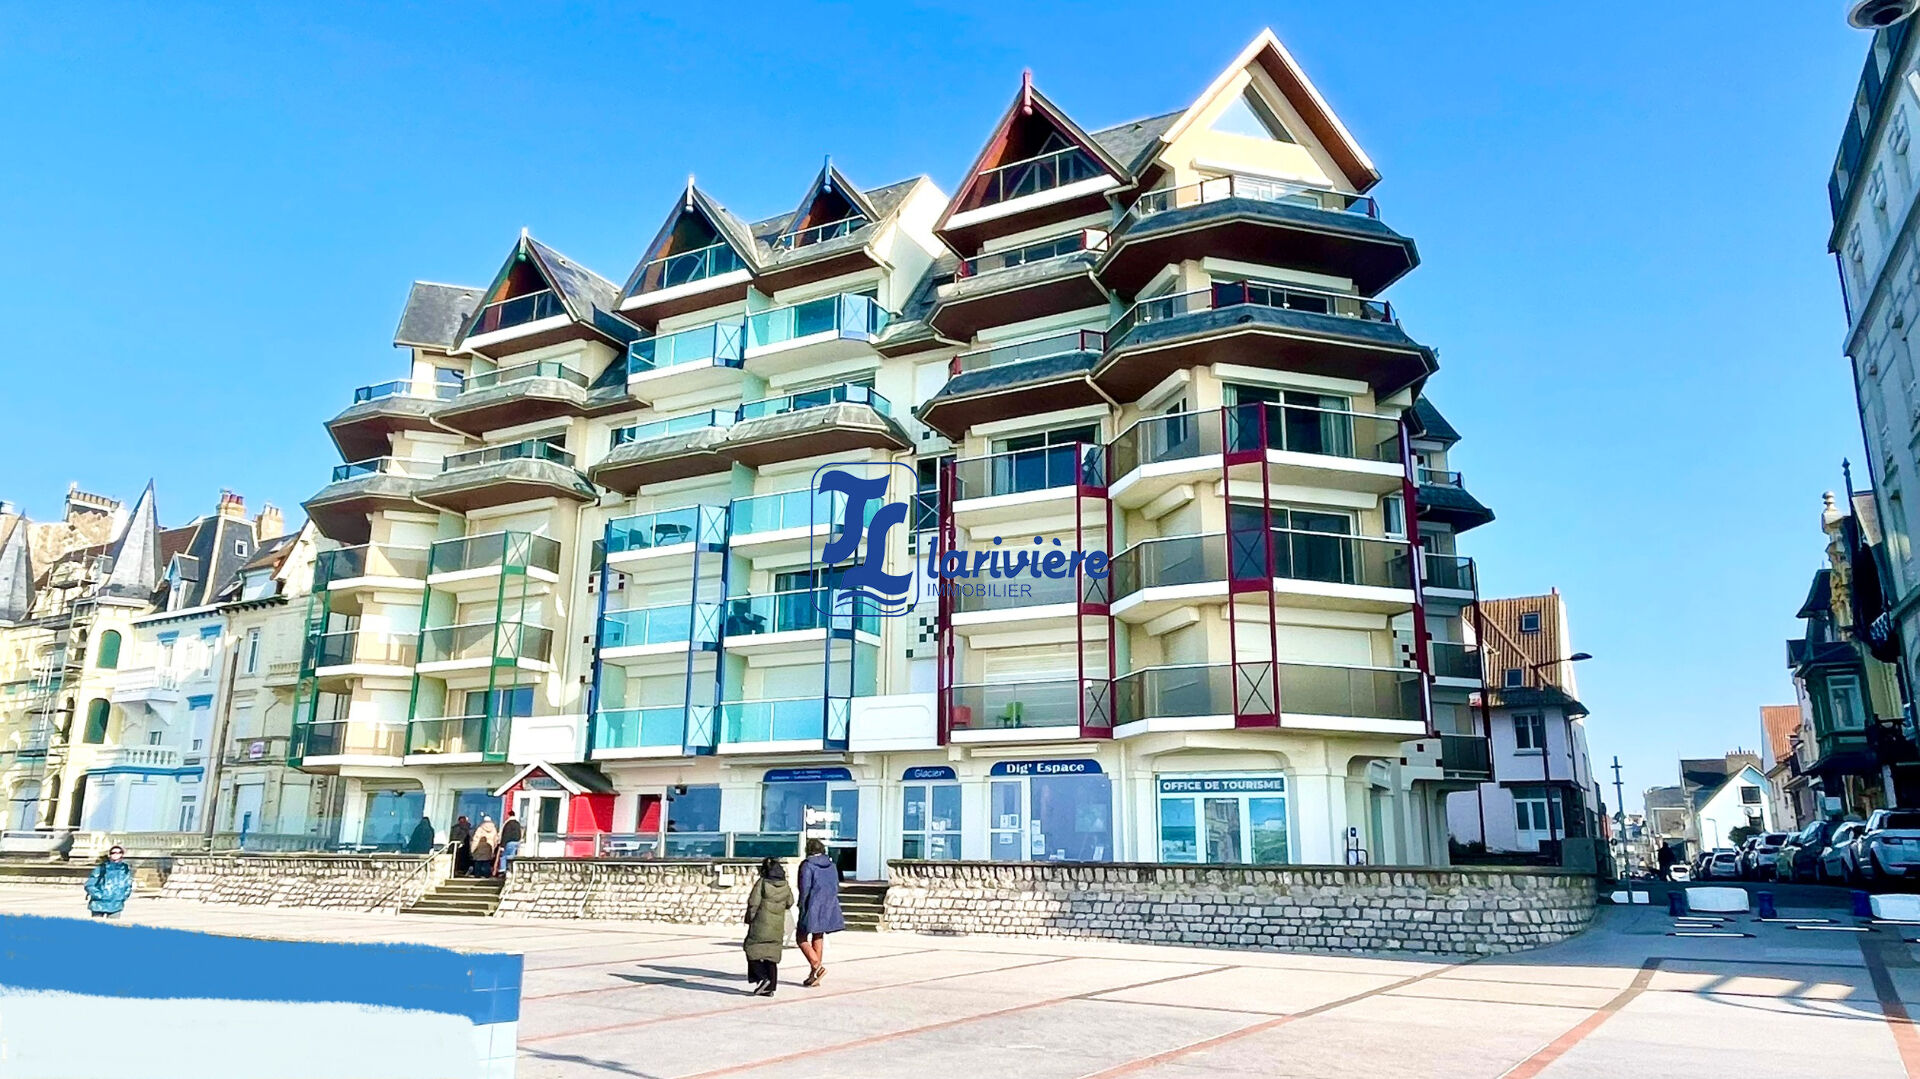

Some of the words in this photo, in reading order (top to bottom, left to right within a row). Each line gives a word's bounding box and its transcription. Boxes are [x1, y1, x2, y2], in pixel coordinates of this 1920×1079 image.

[914, 769, 945, 778] Glacier
[1036, 763, 1085, 774] Espace
[1163, 781, 1201, 791] OFFICE
[1204, 781, 1219, 790] DE
[1222, 780, 1281, 790] TOURISME
